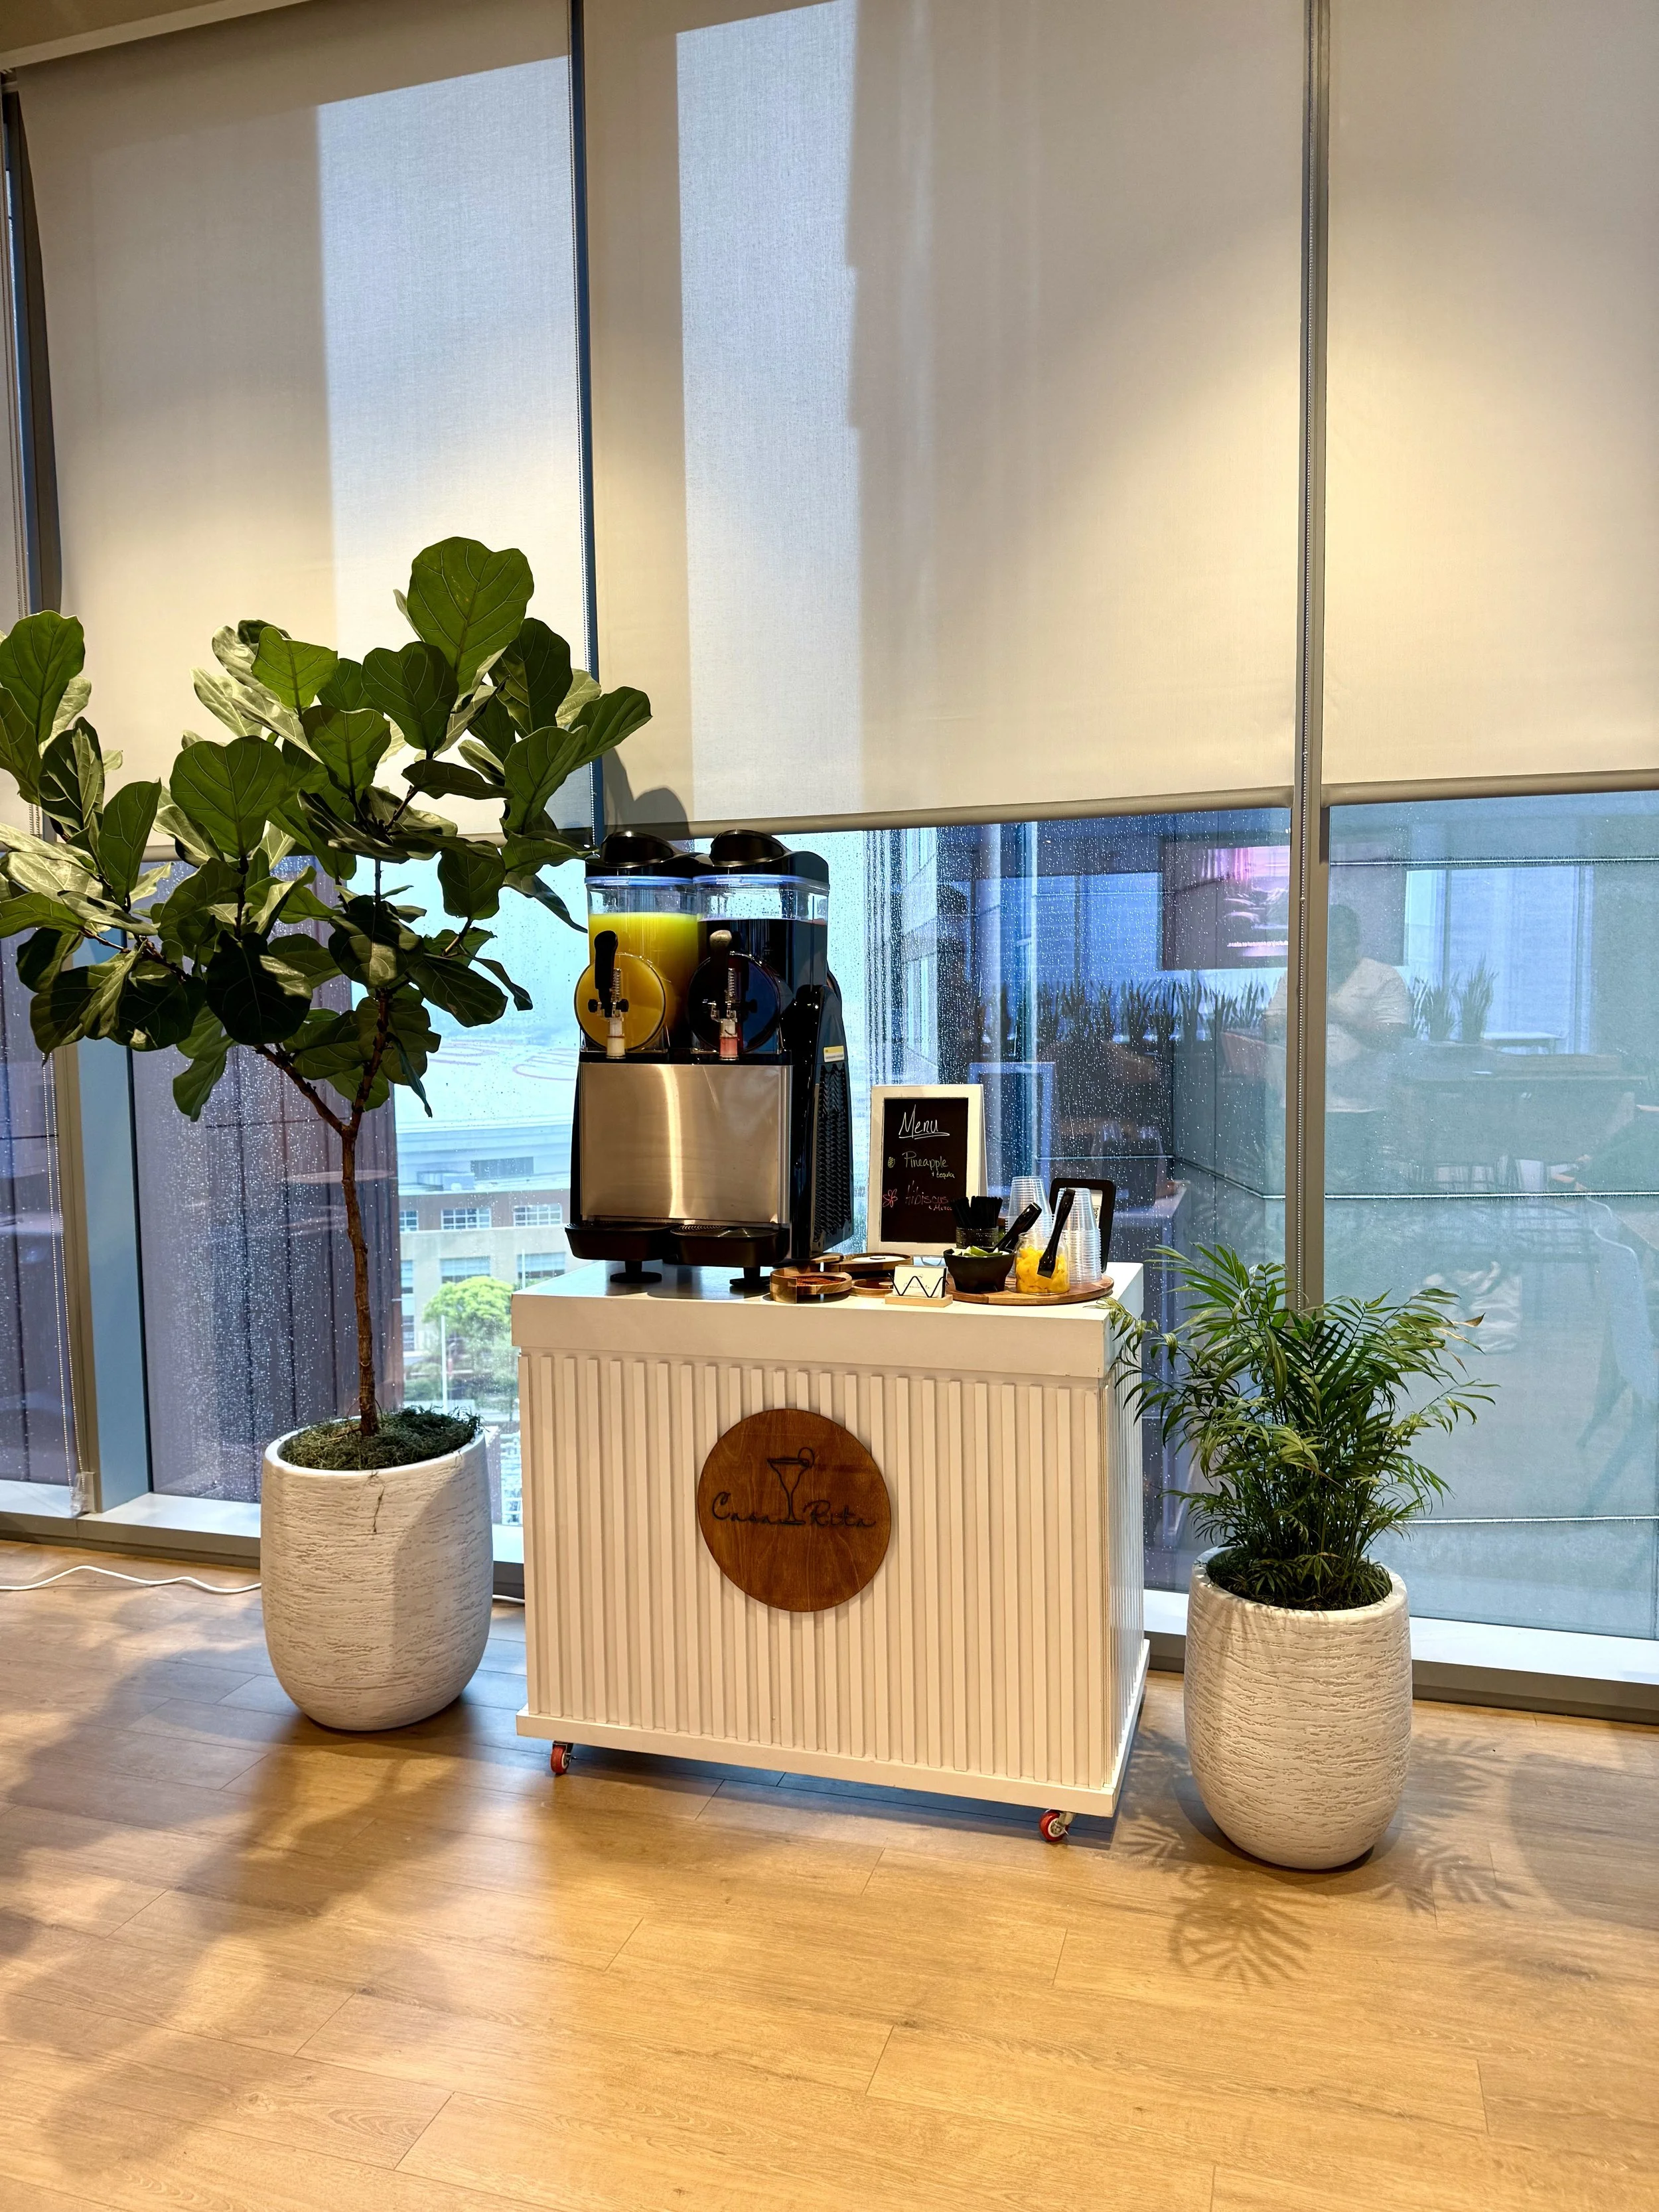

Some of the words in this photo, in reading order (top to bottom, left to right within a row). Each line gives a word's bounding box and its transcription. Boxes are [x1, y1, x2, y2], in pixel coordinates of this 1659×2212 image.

[899, 1104, 938, 1138] Menu
[902, 1151, 948, 1171] Pineapple
[905, 1180, 949, 1205] Hibiscus
[712, 1491, 778, 1525] Casa
[802, 1499, 877, 1526] Rita
